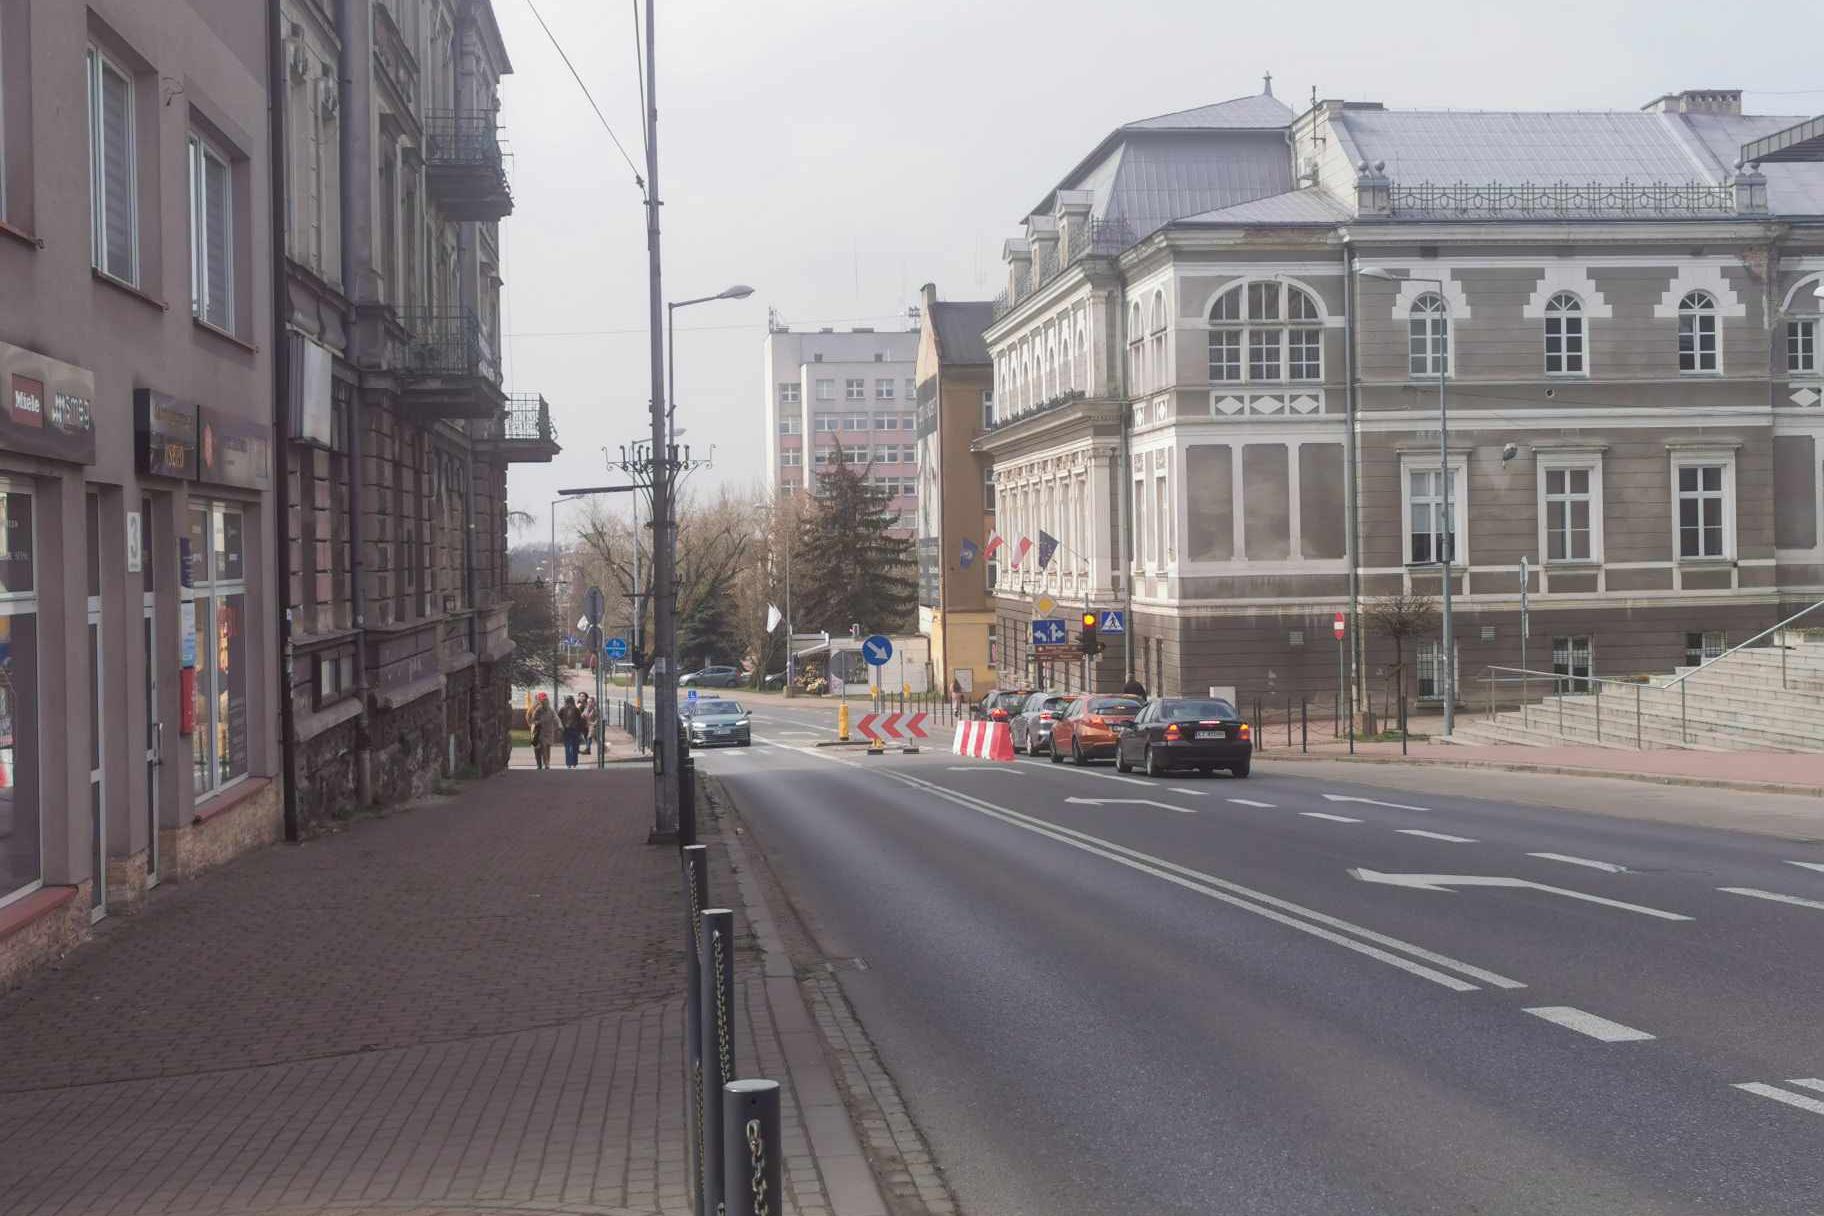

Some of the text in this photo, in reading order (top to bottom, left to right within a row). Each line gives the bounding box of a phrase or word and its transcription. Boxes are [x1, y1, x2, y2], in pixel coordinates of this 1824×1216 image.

[15, 390, 40, 413] Miele
[65, 395, 90, 431] smeg
[130, 516, 139, 559] 3
